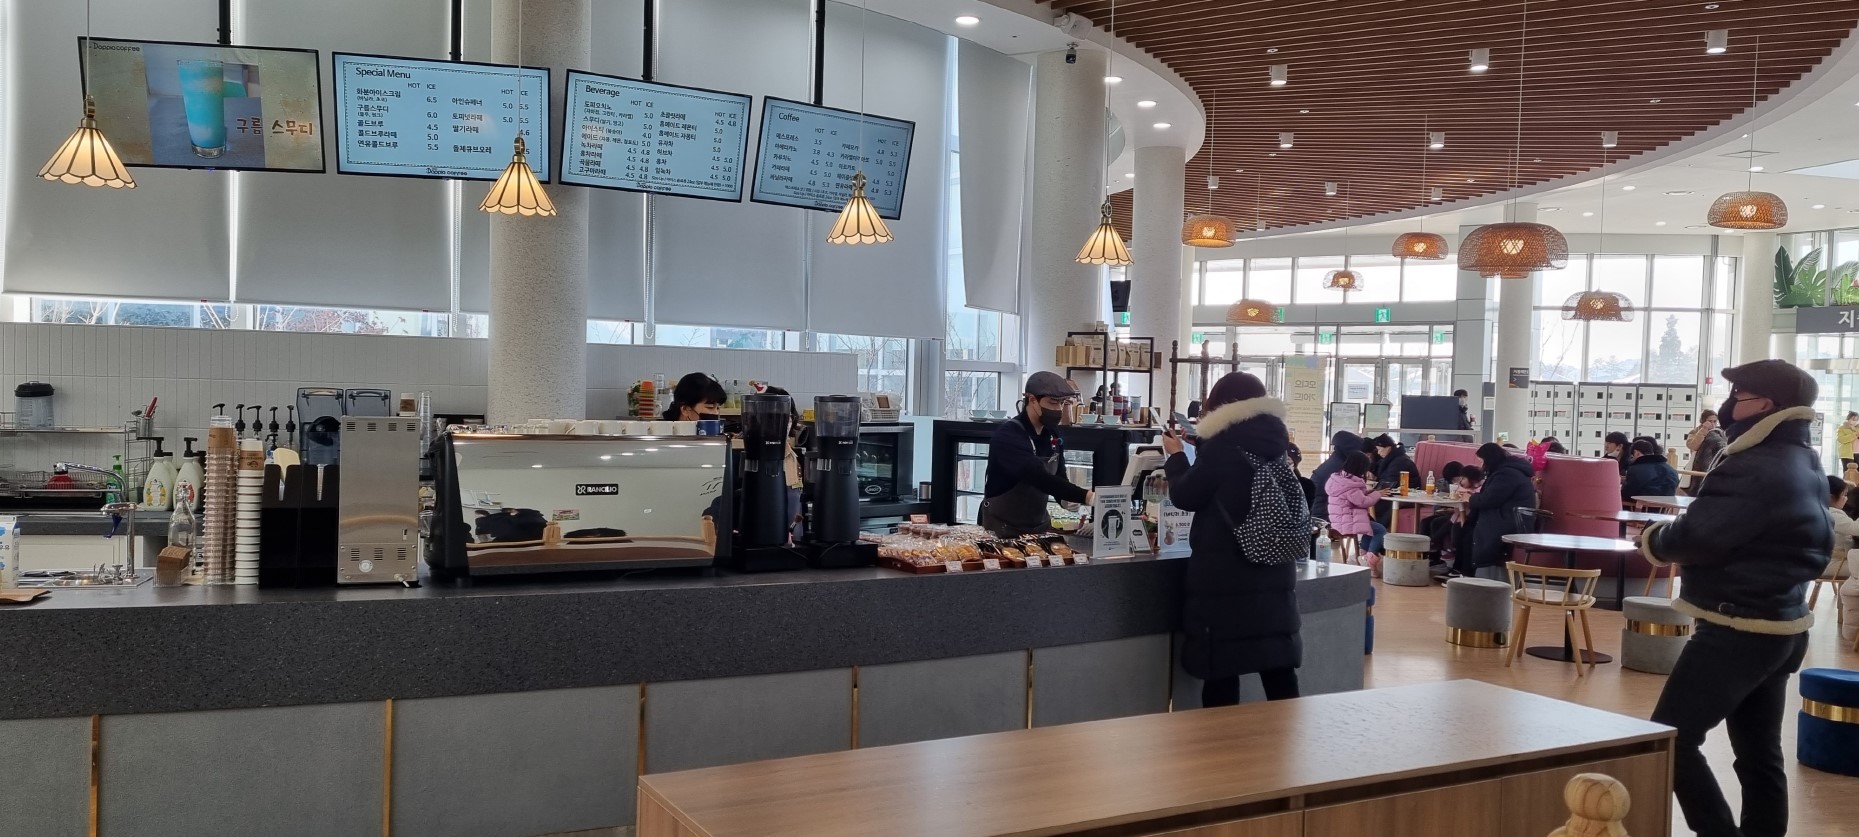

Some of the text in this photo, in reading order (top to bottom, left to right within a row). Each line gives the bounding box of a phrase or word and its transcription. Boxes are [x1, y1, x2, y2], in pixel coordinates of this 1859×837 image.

[355, 67, 411, 79] Special Menu
[356, 87, 401, 99] 화분아이스크림
[585, 84, 620, 98] Beverage
[451, 97, 483, 107] 아인슈페너
[356, 103, 389, 113] 구름스무디
[452, 112, 484, 122] 토피넛라떼
[779, 113, 799, 122] Coffee
[236, 117, 313, 136] 구름 스무디
[356, 119, 385, 128] 콜드브루
[358, 129, 398, 139] 콜드브루라떼
[452, 125, 480, 134] 딸기라떼
[581, 124, 605, 134] 아이스티
[357, 139, 399, 149] 연유콜드브루
[580, 141, 603, 151] 녹차라떼
[657, 139, 674, 148] 유자차
[578, 166, 607, 176] 고구마라떼
